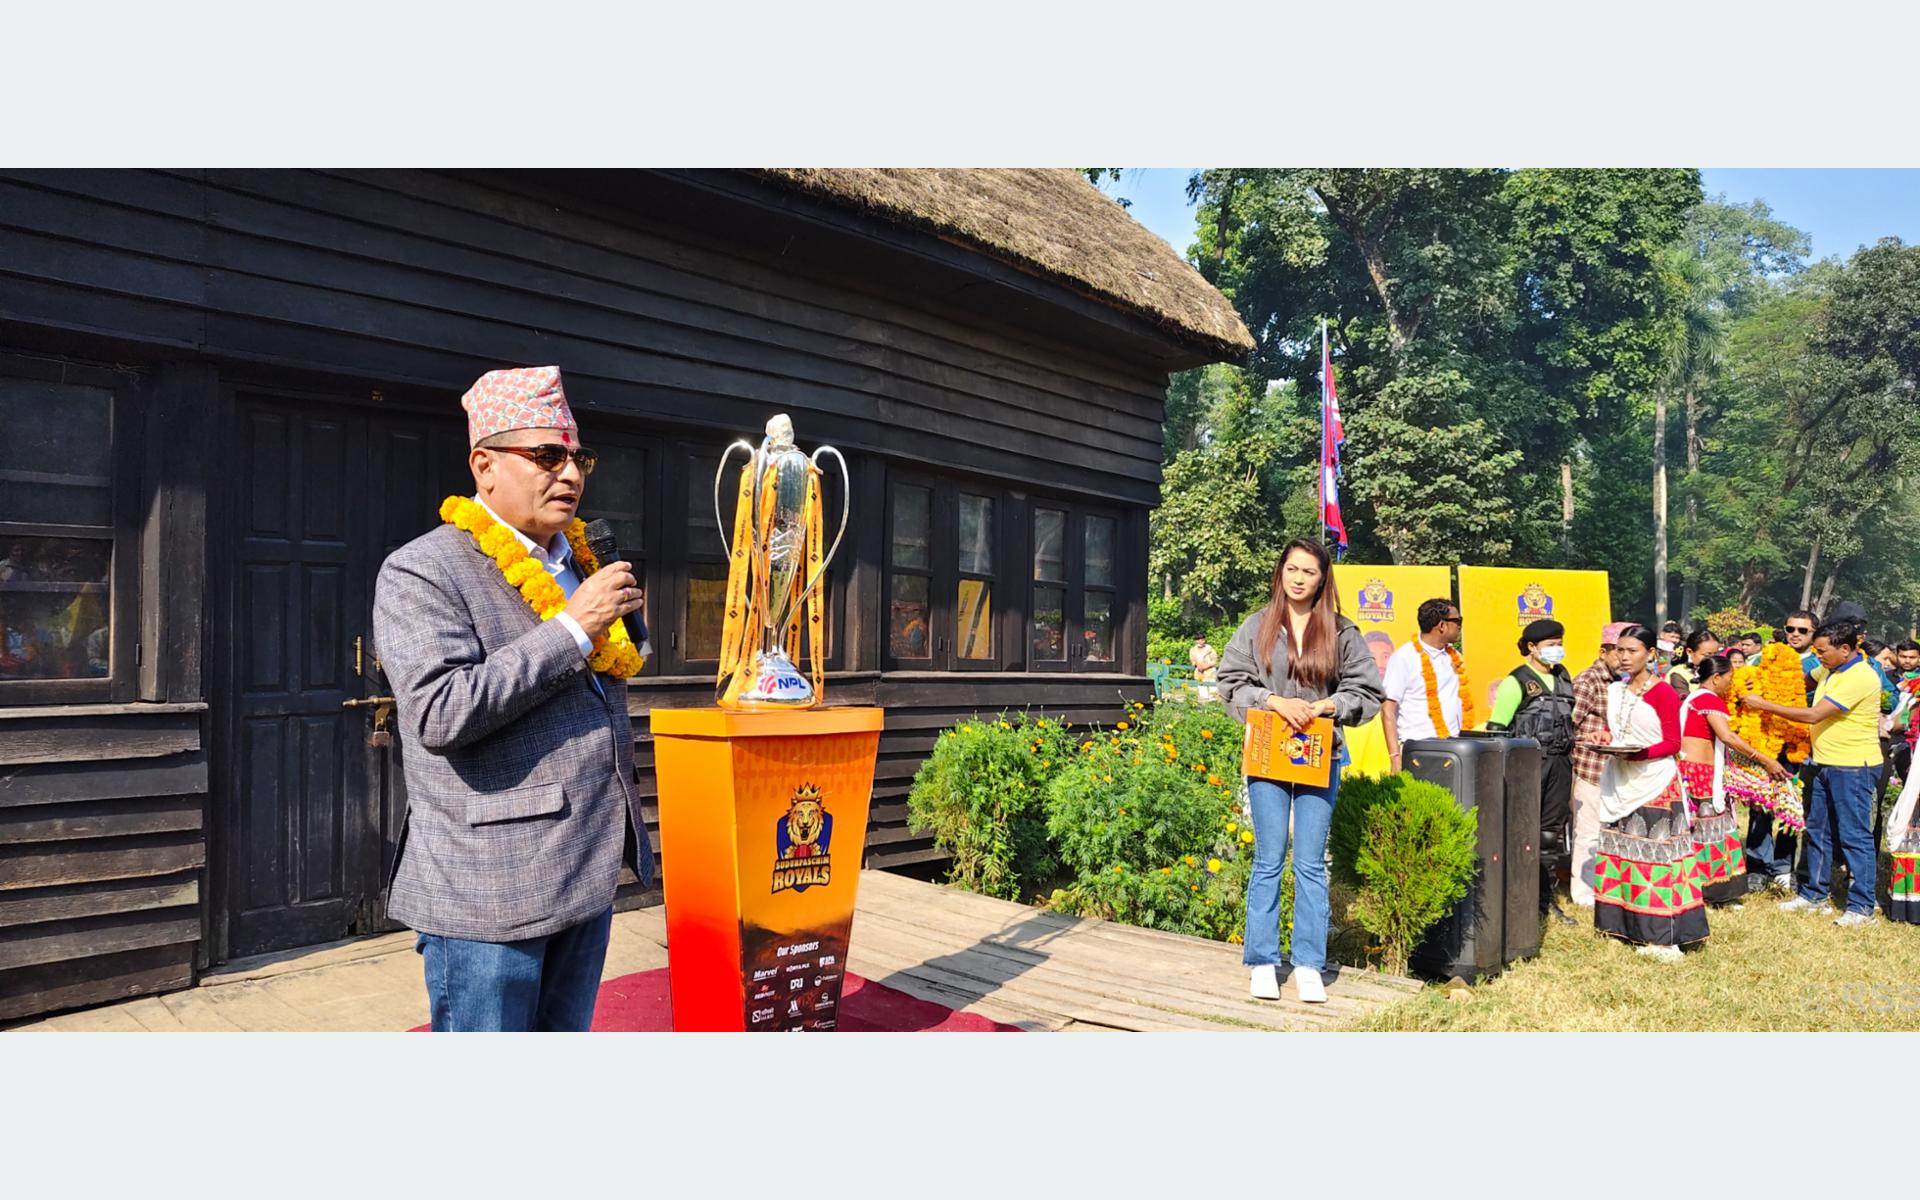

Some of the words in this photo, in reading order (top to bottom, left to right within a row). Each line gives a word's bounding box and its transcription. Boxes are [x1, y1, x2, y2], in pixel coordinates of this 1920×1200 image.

[778, 677, 806, 690] NPL
[773, 866, 830, 893] ROYALS
[777, 946, 789, 957] Our
[790, 941, 819, 956] Sponsors
[753, 967, 778, 979] Marvel
